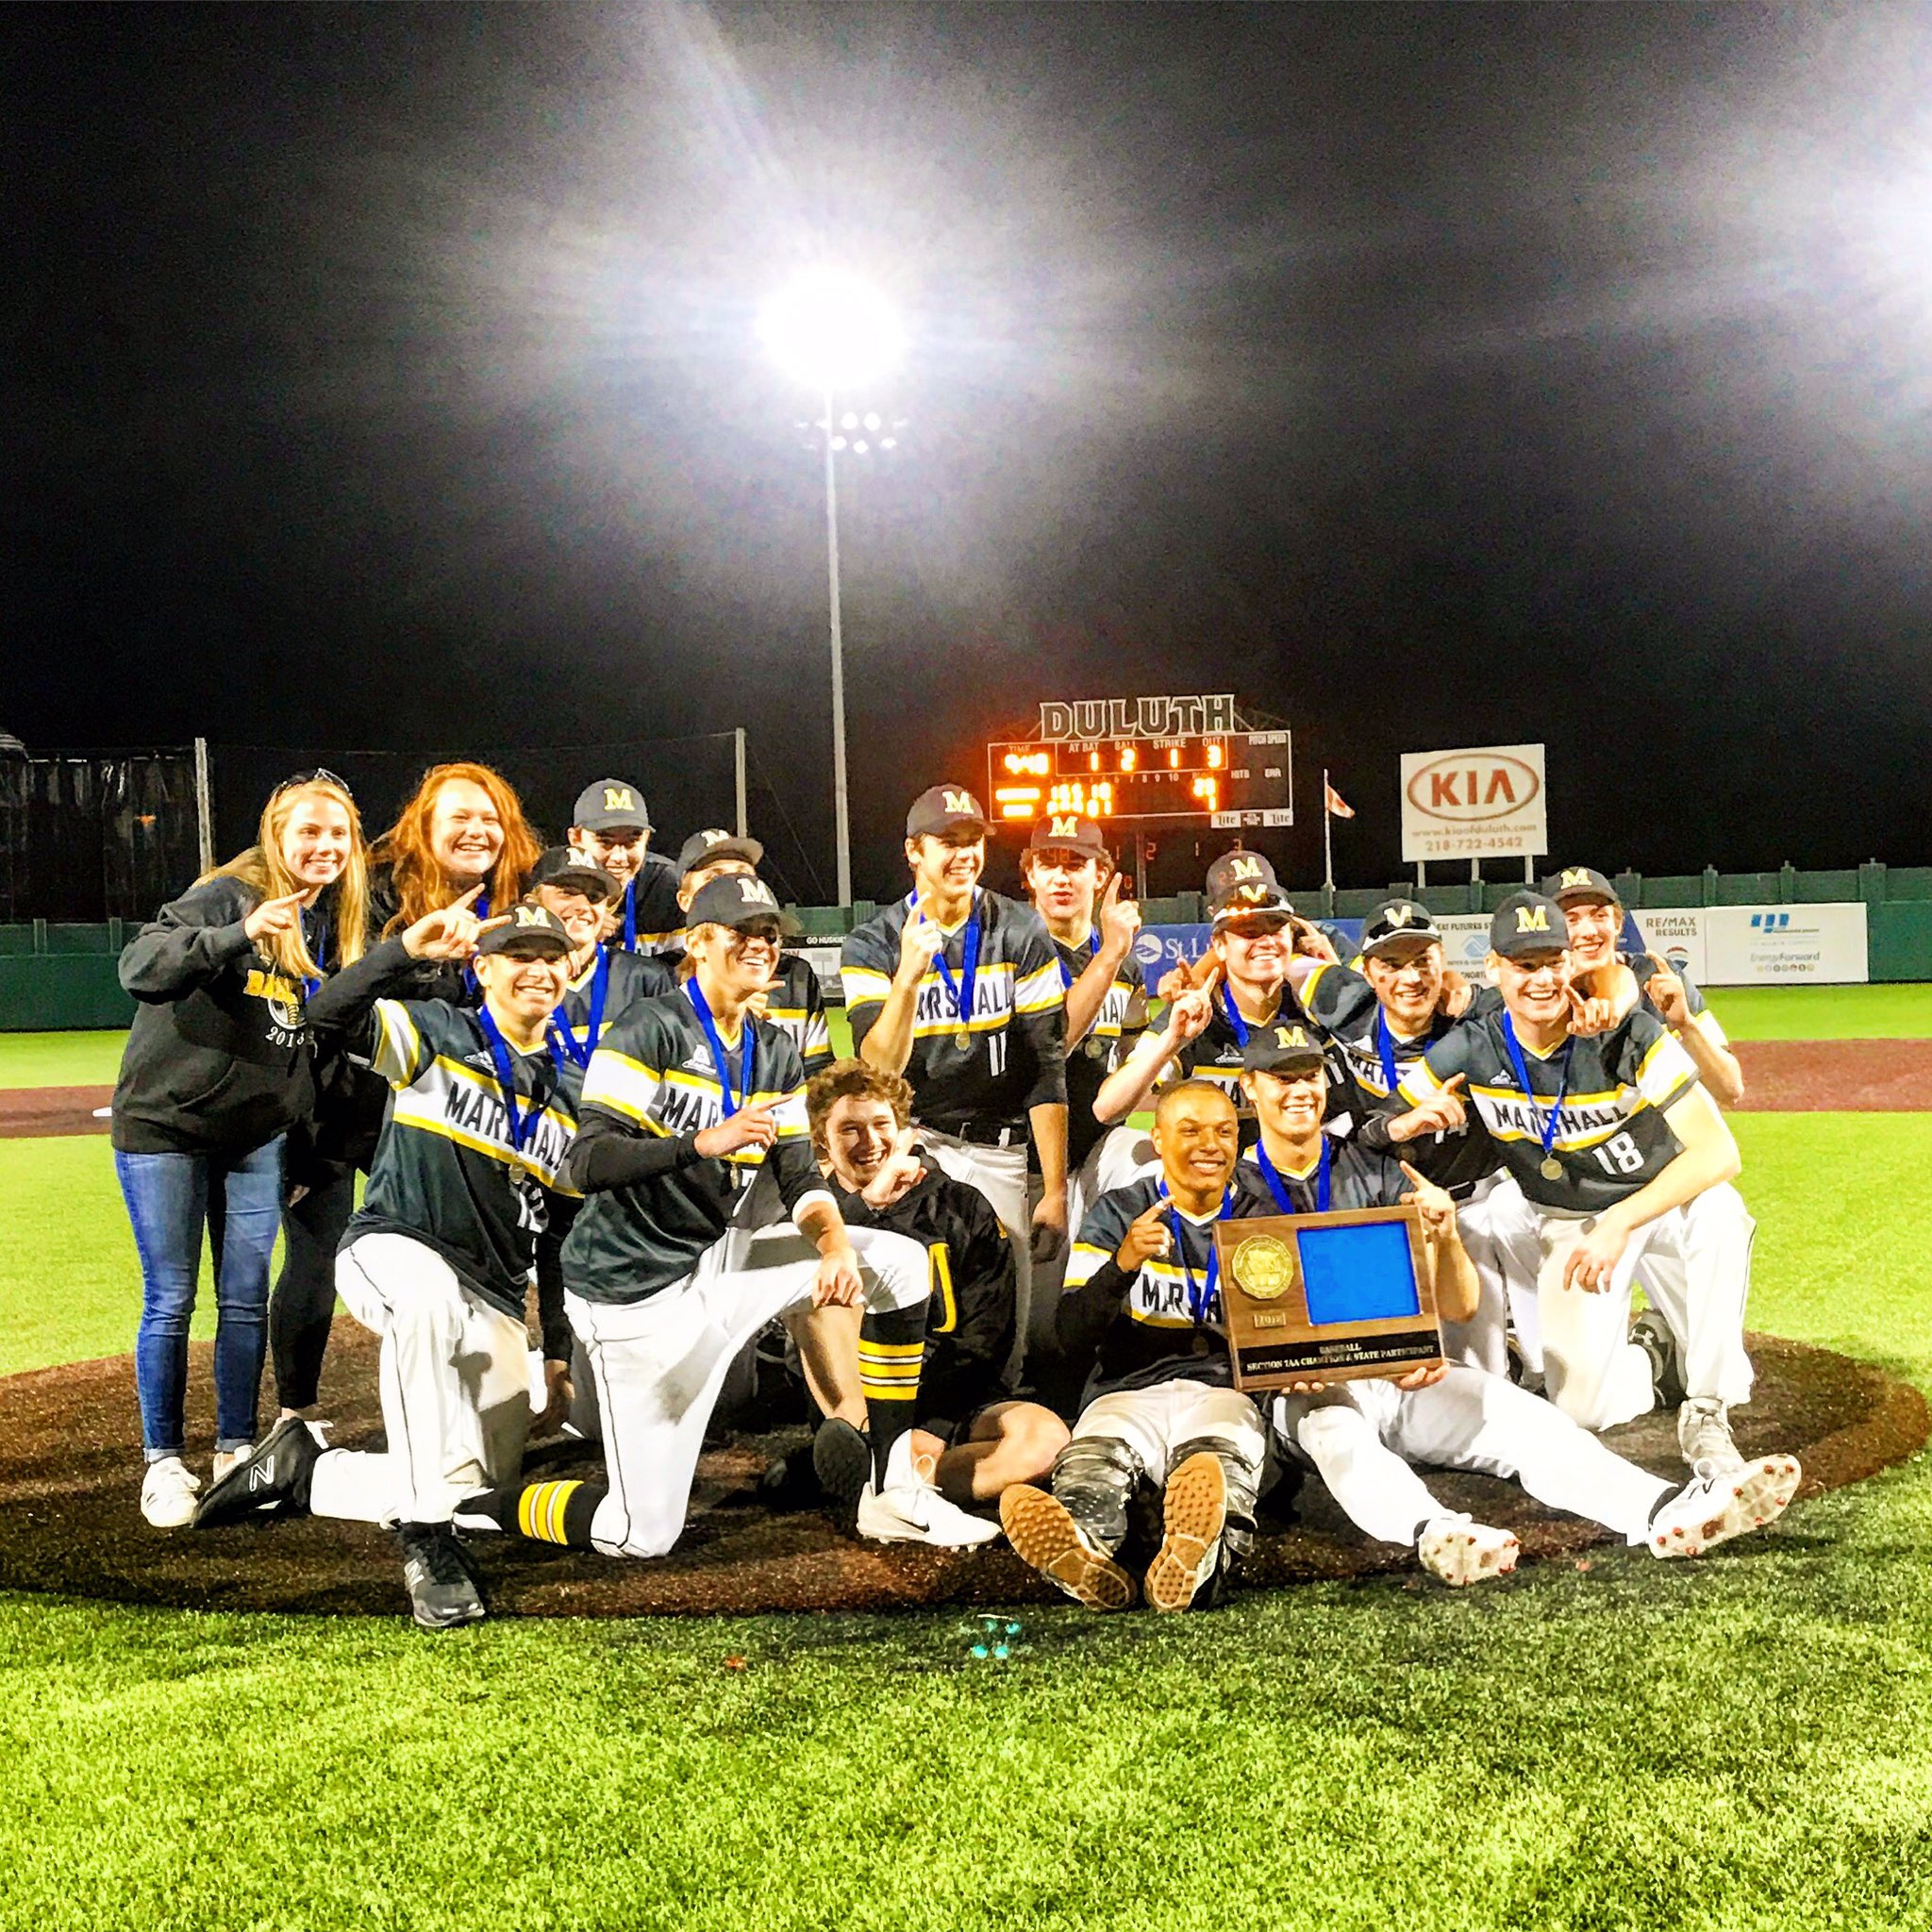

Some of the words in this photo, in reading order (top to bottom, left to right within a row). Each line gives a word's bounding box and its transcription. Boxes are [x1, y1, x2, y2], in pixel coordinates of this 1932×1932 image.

[1040, 695, 1235, 741] DULUTH
[1068, 743, 1080, 753] AT
[1082, 742, 1099, 753] BAT
[1115, 741, 1138, 750] BALL
[1153, 739, 1186, 749] STRIKE
[1202, 737, 1222, 747] OUT
[1120, 748, 1135, 772] 2
[1169, 772, 1179, 782] 10
[604, 788, 634, 811] M
[1430, 769, 1516, 808] KIA
[942, 791, 974, 814] M
[1048, 816, 1078, 838] M
[1411, 824, 1537, 838] www.kiaofduluth.com
[1425, 836, 1523, 851] 218-722-4542
[567, 847, 596, 869] M
[1230, 856, 1263, 881] M
[1560, 867, 1592, 890] M
[738, 877, 774, 907] M
[515, 906, 551, 928] M
[1515, 905, 1550, 933] M
[1646, 917, 1695, 927] RE/MAX
[807, 936, 818, 944] GO
[1274, 1025, 1310, 1049] M
[988, 1030, 1007, 1077] 11
[1592, 1131, 1644, 1175] 18
[1246, 1359, 1283, 1372] SECTION
[1301, 1353, 1345, 1366] CHAMPION
[1354, 1350, 1379, 1361] STATE
[1381, 1344, 1434, 1358] PARTICIPANT
[1319, 1342, 1362, 1355] BASEBALL
